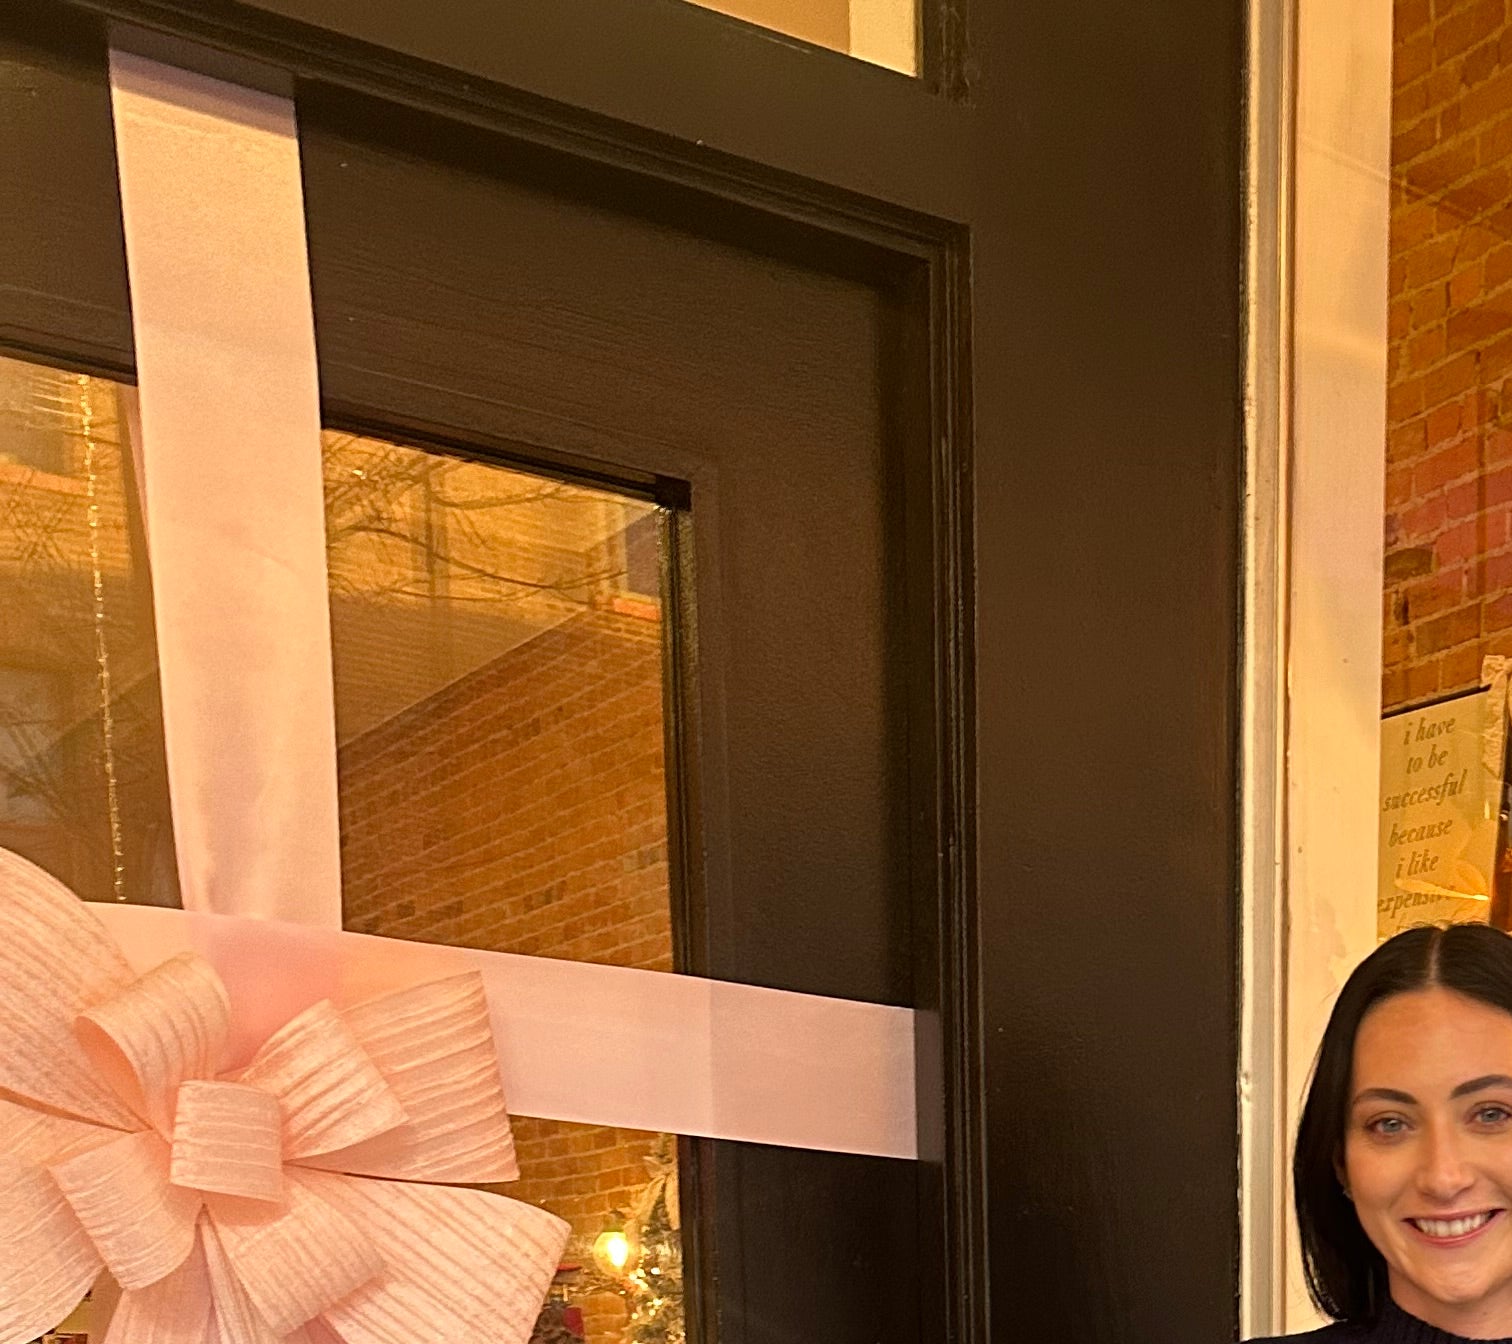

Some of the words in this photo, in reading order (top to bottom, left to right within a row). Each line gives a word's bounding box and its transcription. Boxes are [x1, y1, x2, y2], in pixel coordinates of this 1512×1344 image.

[1403, 722, 1413, 745] i
[1415, 716, 1456, 742] have
[1406, 756, 1423, 774] to
[1427, 743, 1449, 768] be
[1382, 768, 1468, 812] successful
[1388, 819, 1453, 848] because
[1395, 857, 1405, 879] i
[1407, 849, 1439, 877] like
